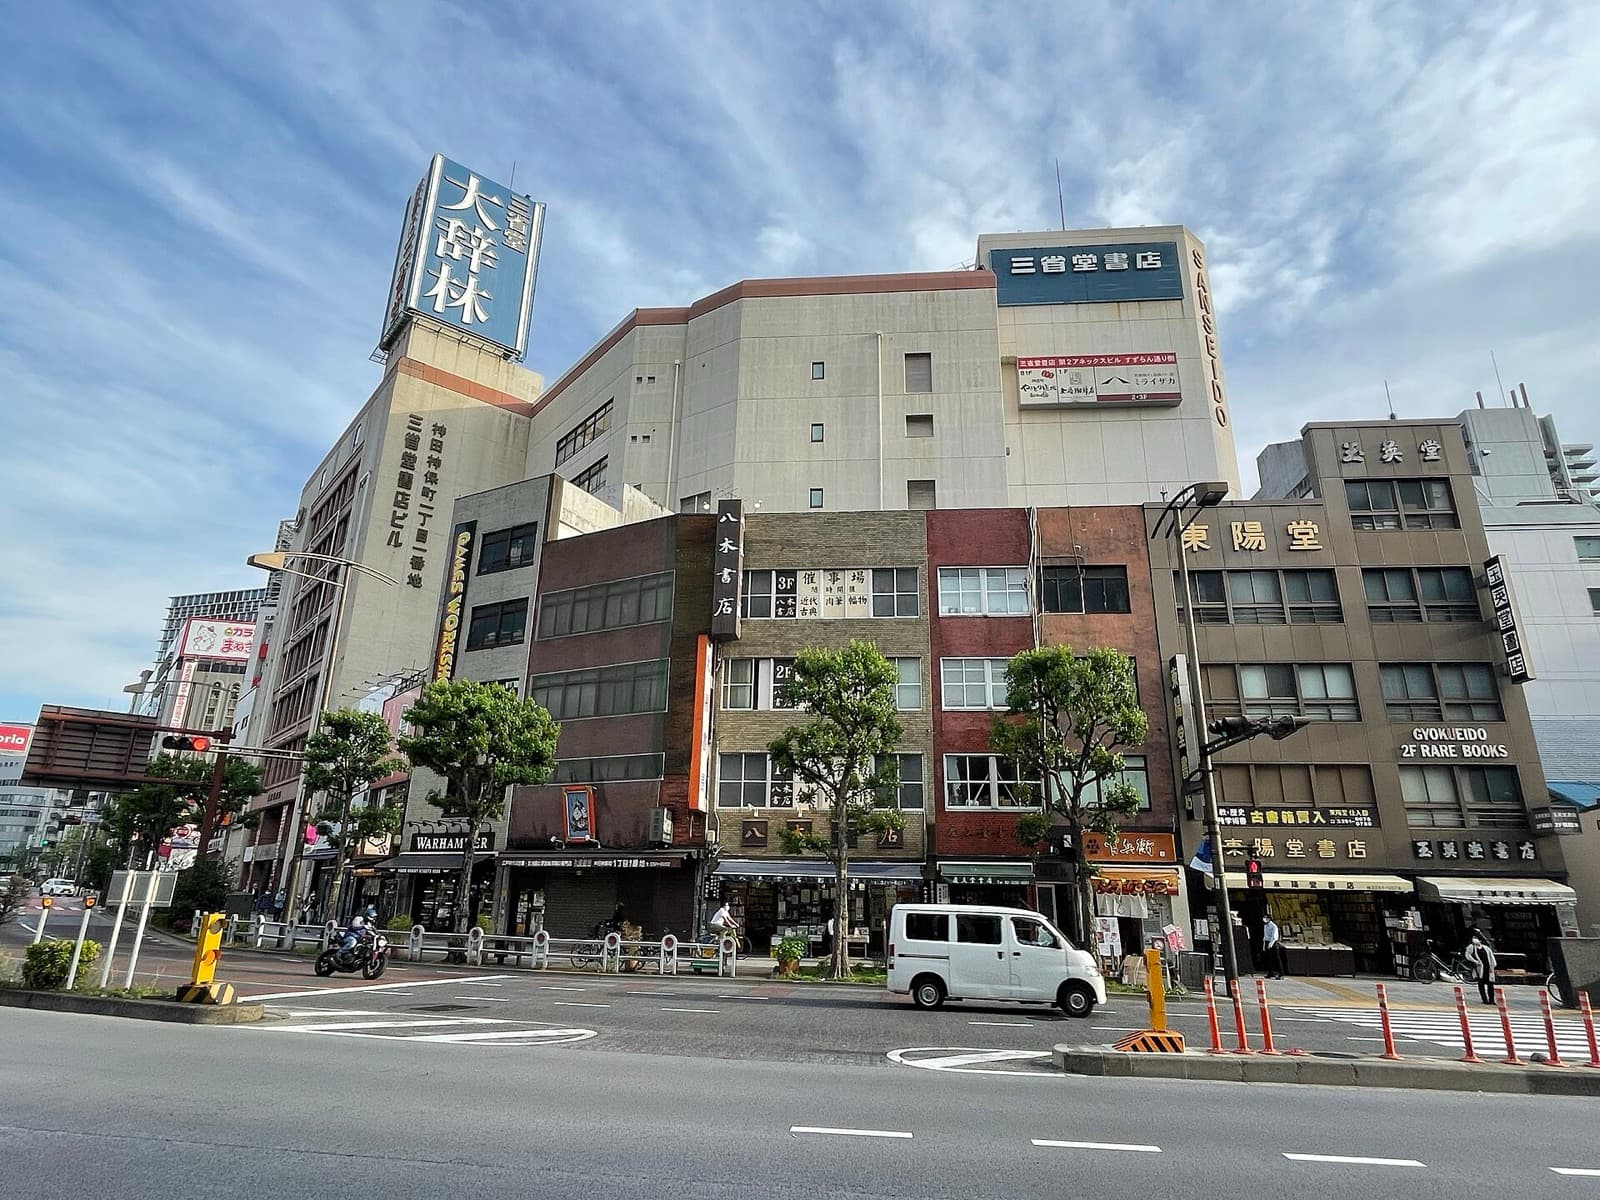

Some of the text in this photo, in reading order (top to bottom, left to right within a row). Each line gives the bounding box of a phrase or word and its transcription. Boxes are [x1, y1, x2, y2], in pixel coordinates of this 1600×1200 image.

[423, 173, 504, 325] 大辞林
[1010, 252, 1162, 274] 三省堂書店
[1192, 249, 1227, 428] SANSEIDO
[1342, 439, 1442, 463] 玉英堂
[387, 413, 423, 548] 三省堂書店ビル
[406, 422, 447, 589] 神田神保町一丁目一番地
[1183, 519, 1323, 551] 東陽堂
[449, 530, 470, 594] GAMES
[713, 512, 739, 617] 八木書店
[778, 576, 795, 590] 3F
[803, 570, 865, 585] 催事場
[1412, 727, 1488, 741] GYOKUEIDO
[1400, 744, 1508, 758] 2F RARE BOOKS
[417, 836, 488, 850] WARHAMER
[1417, 841, 1536, 860] 玉英堂書店
